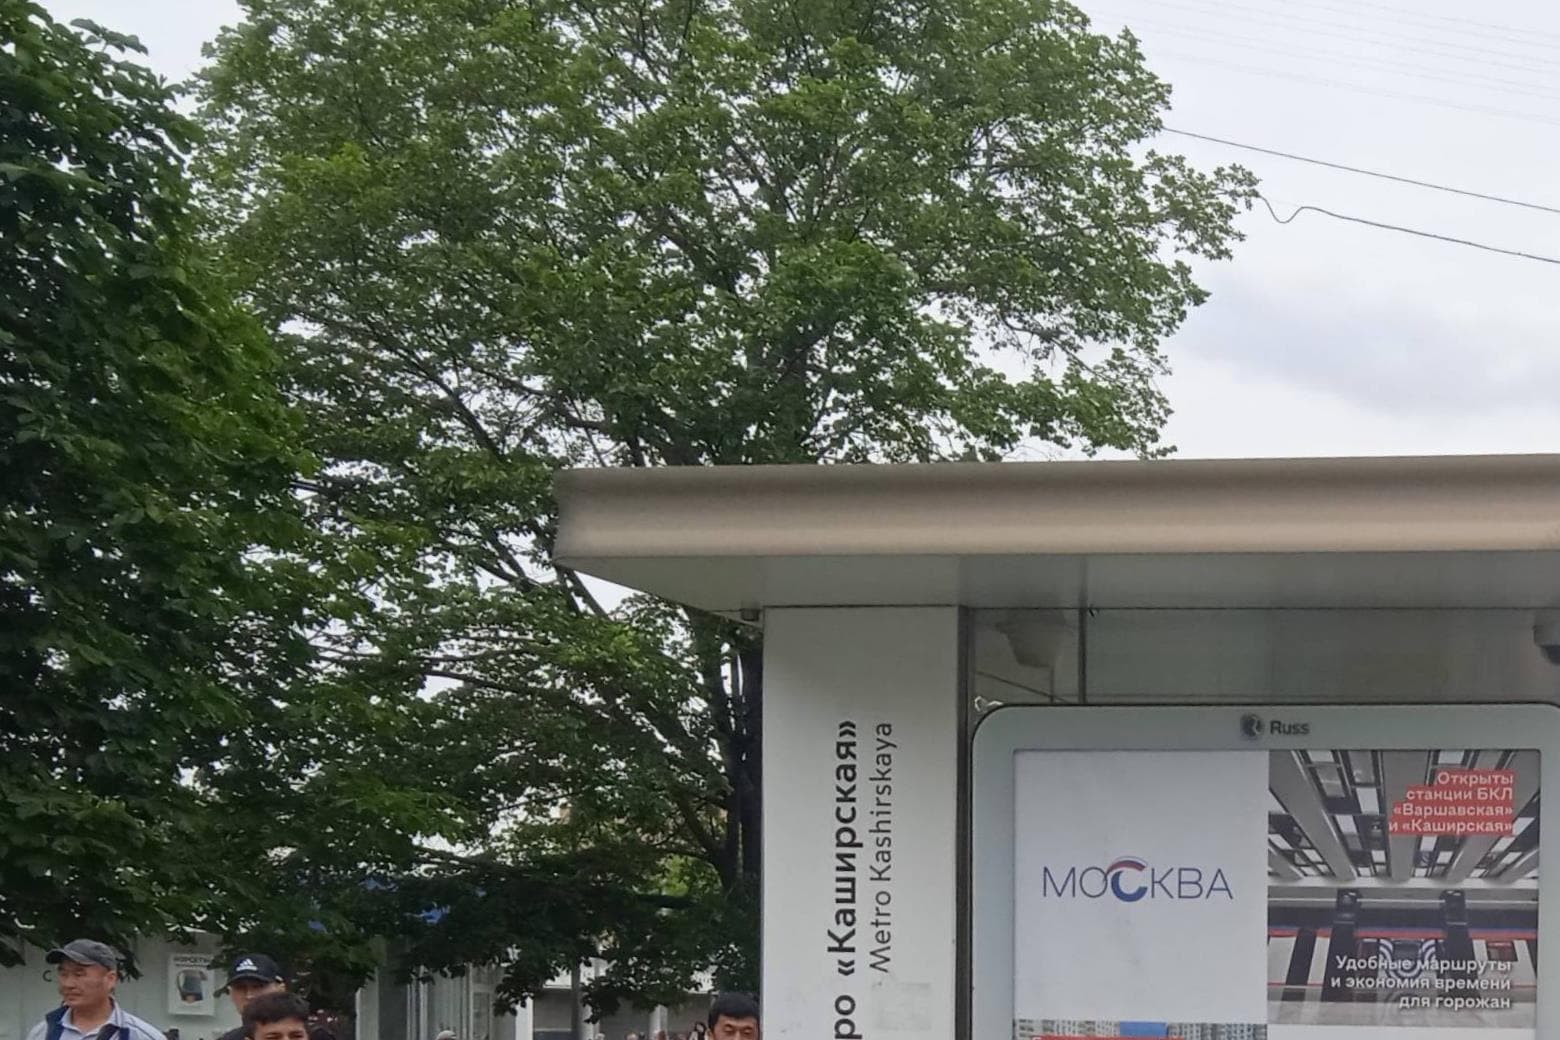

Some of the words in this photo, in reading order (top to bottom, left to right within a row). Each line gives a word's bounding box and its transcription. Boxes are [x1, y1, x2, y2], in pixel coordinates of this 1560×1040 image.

[1270, 720, 1310, 735] Russ
[1437, 771, 1513, 787] Открыты
[869, 723, 898, 881] Kashirskaya
[1406, 788, 1472, 802] станции
[1477, 788, 1512, 800] БКЛ
[1393, 803, 1513, 818] «Варшавская»
[1389, 822, 1398, 831] и
[1402, 819, 1513, 835] «Каширская»
[827, 720, 863, 976] «Каширская»
[1043, 856, 1234, 902] МОСКВА
[869, 890, 892, 973] Metro
[1336, 955, 1411, 972] Удобные
[1416, 958, 1511, 974] маршруты
[1331, 977, 1341, 987] и
[1345, 976, 1429, 989] экономия
[1434, 978, 1511, 992] времени
[1399, 996, 1430, 1009] для
[1435, 997, 1510, 1011] горожан
